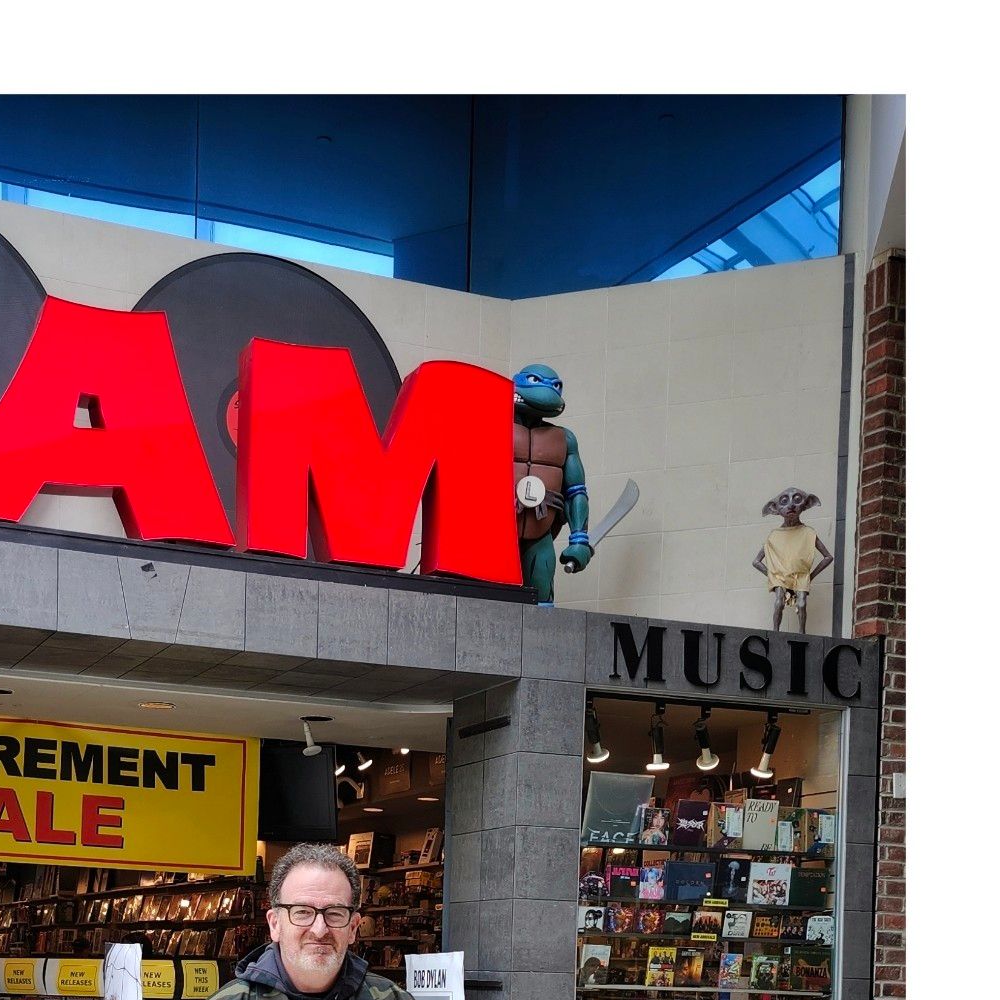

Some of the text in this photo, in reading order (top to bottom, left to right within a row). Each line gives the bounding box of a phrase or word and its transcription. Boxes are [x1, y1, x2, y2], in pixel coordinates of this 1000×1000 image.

[525, 481, 537, 502] L
[609, 622, 862, 699] MUSIC
[747, 801, 776, 813] READY
[747, 813, 758, 823] TO
[13, 969, 25, 977] NEW
[795, 966, 827, 977] BONANZA
[7, 977, 32, 985] RELEASES
[60, 979, 93, 987] RELEASES
[414, 969, 447, 988] BOB DYLAN
